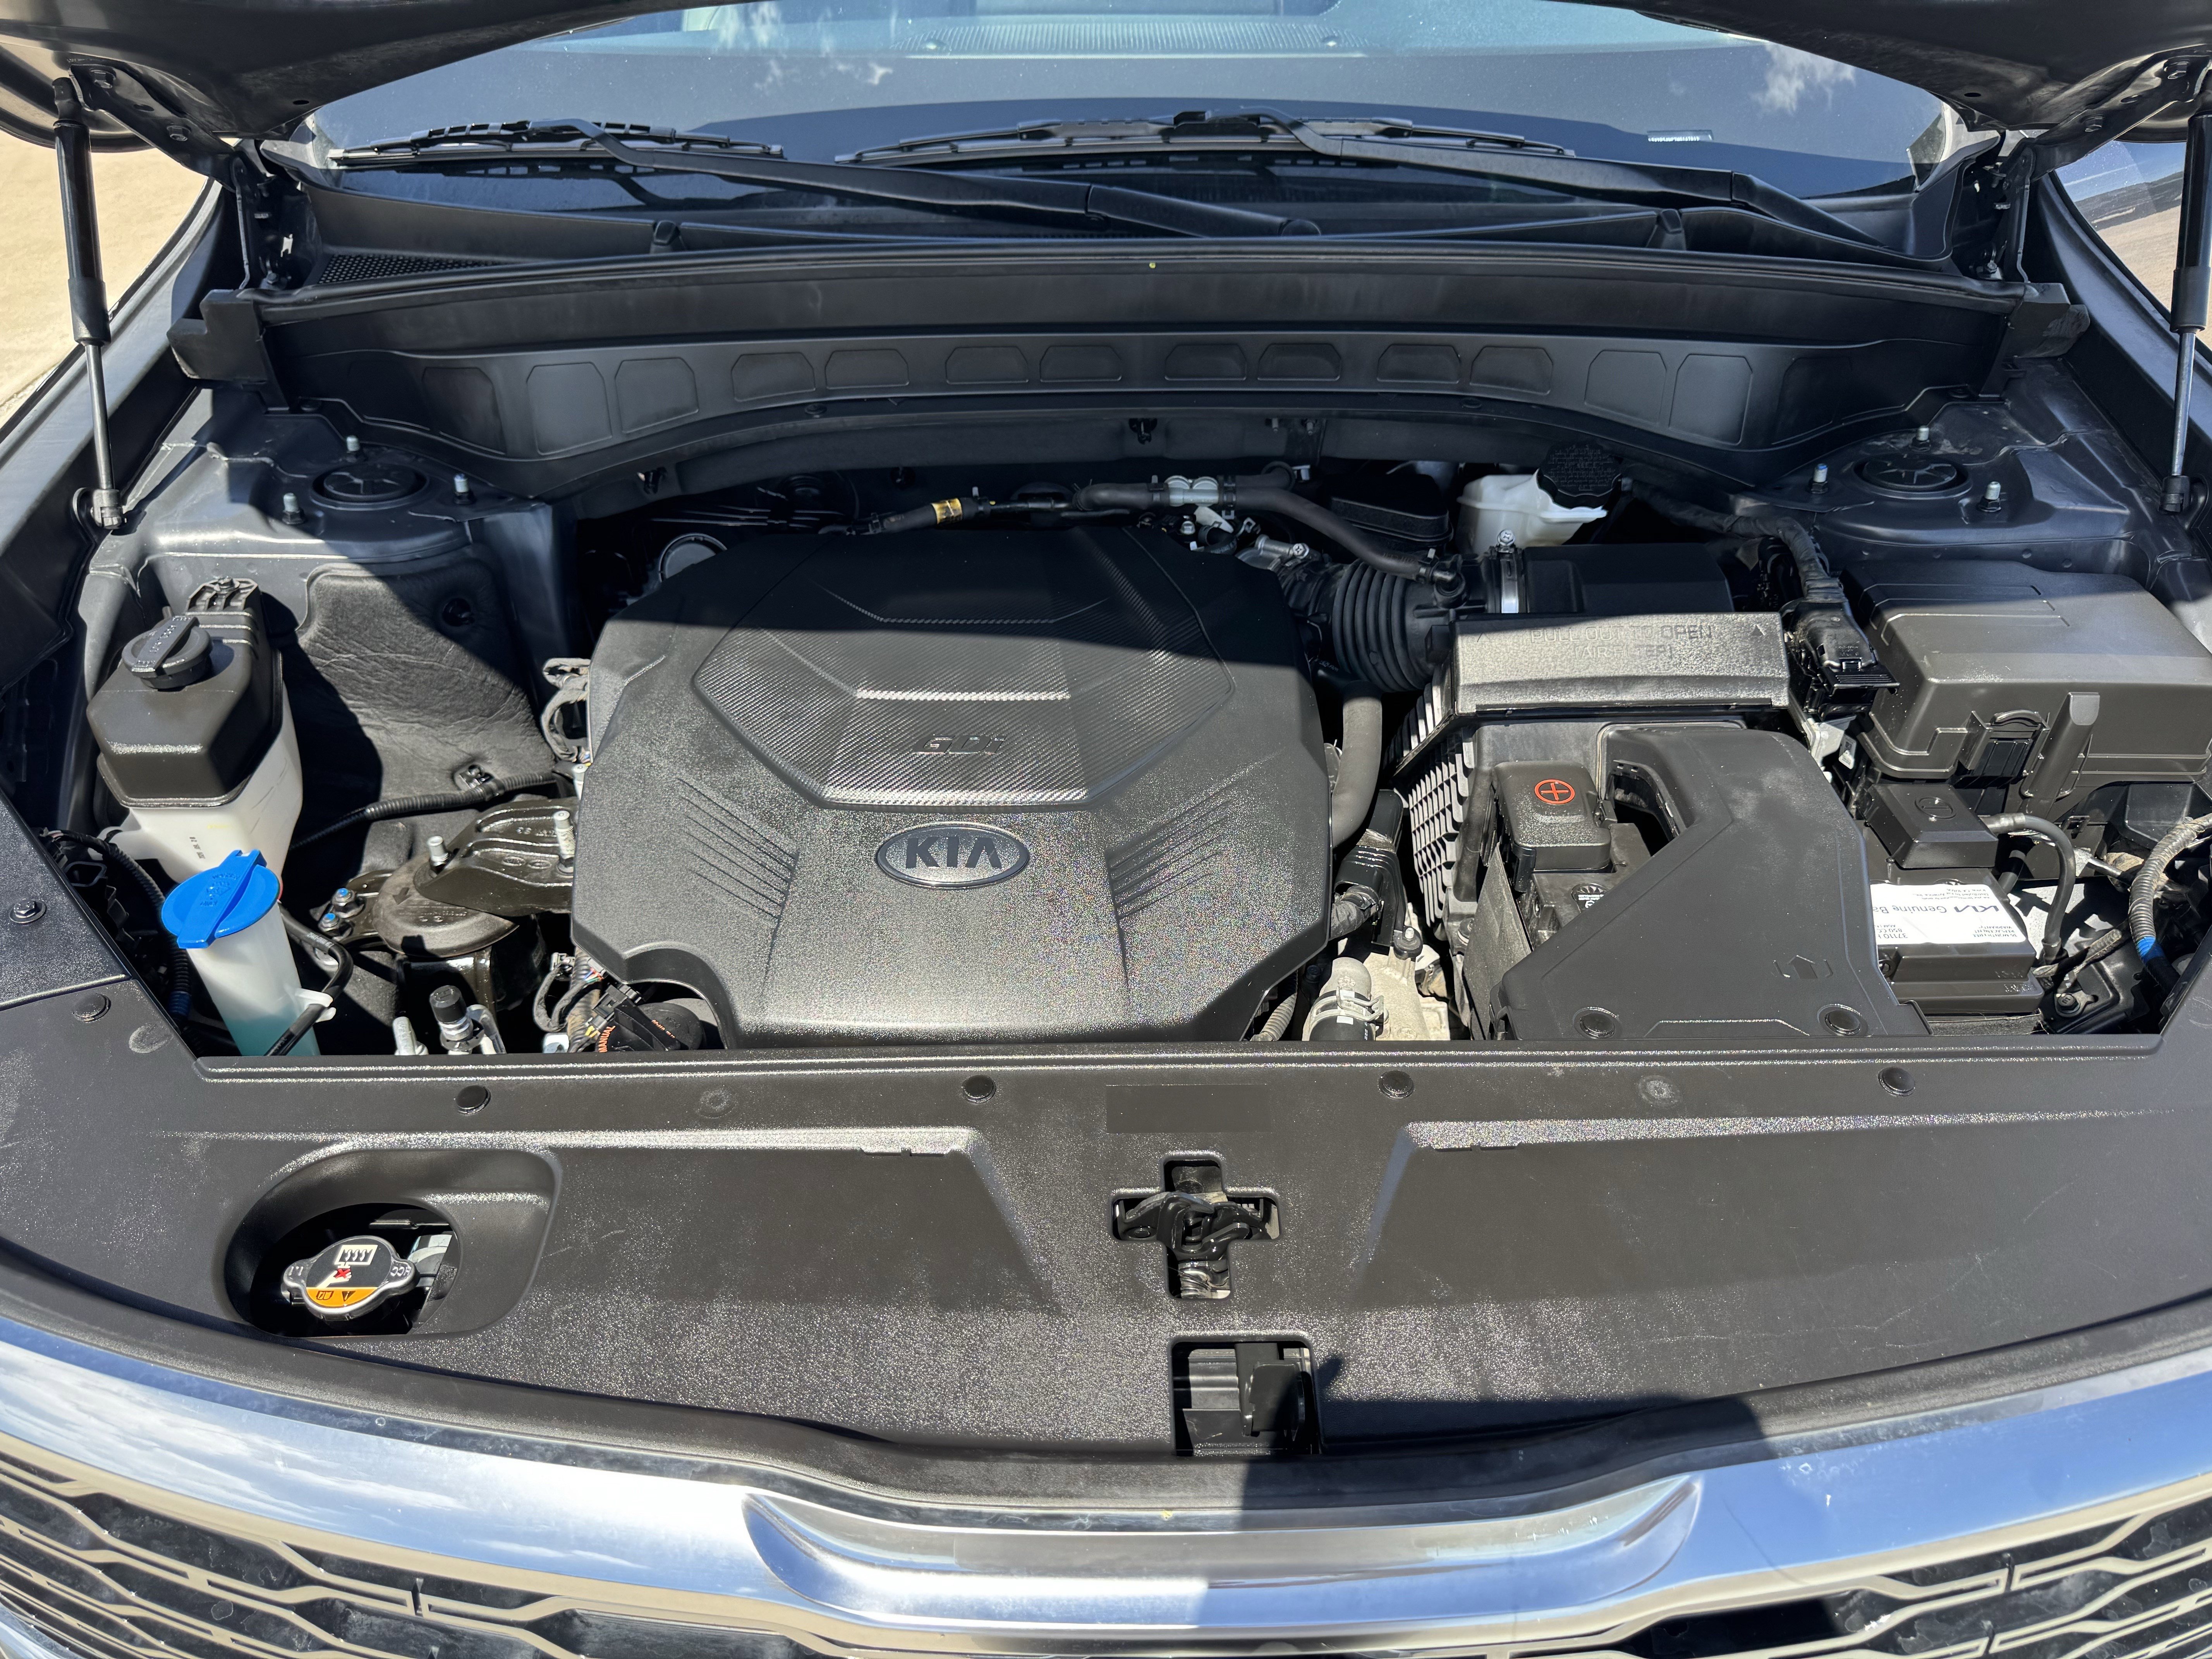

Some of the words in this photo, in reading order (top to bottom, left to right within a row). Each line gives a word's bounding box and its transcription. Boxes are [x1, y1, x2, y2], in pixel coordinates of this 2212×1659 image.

[1531, 628, 1580, 643] PULL
[1585, 625, 1624, 641] OUT
[1629, 625, 1653, 640] TO
[1661, 625, 1712, 639] OPEN
[906, 836, 1002, 868] KIA
[598, 1025, 616, 1053] MANUAL
